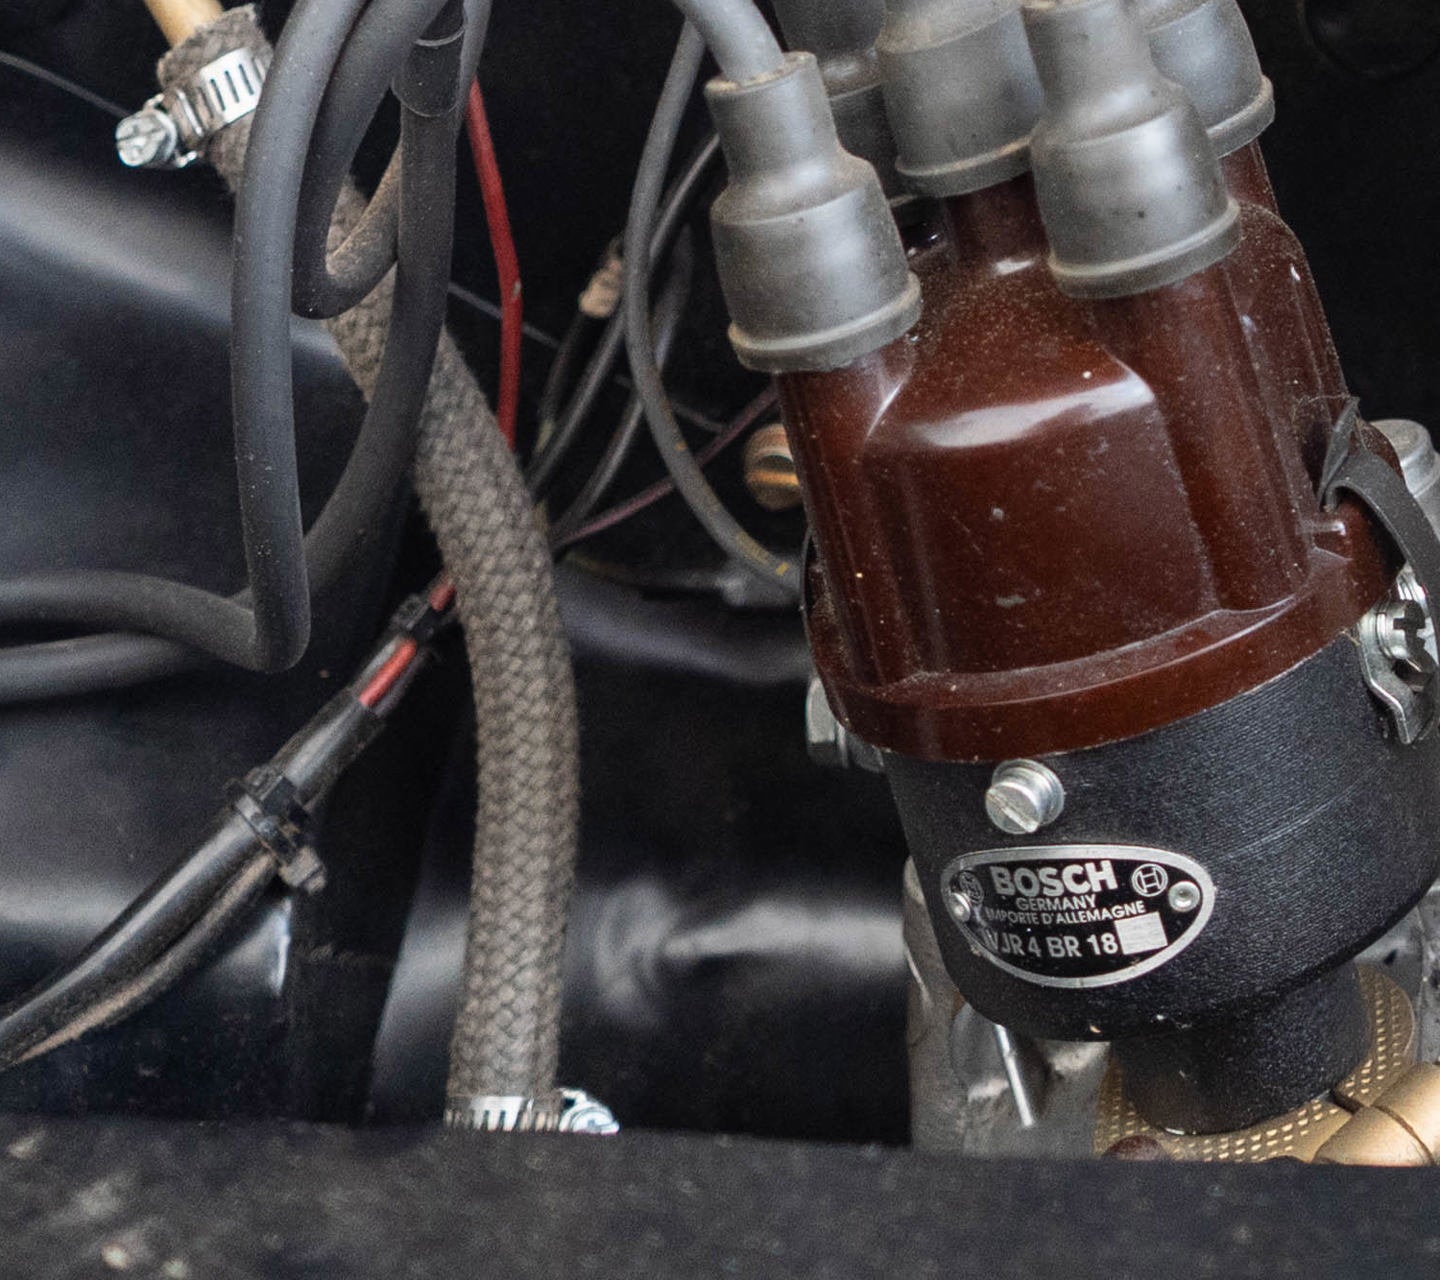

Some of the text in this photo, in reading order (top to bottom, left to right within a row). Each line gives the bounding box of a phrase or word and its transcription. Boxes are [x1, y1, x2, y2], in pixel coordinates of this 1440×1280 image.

[990, 860, 1118, 896] BOSCH
[986, 900, 1146, 924] IMPORTE D'ALLEMAGNE
[1016, 895, 1096, 912] GERMANY
[1027, 936, 1042, 958] 4
[1047, 936, 1082, 958] BR
[1087, 933, 1119, 955] 18
